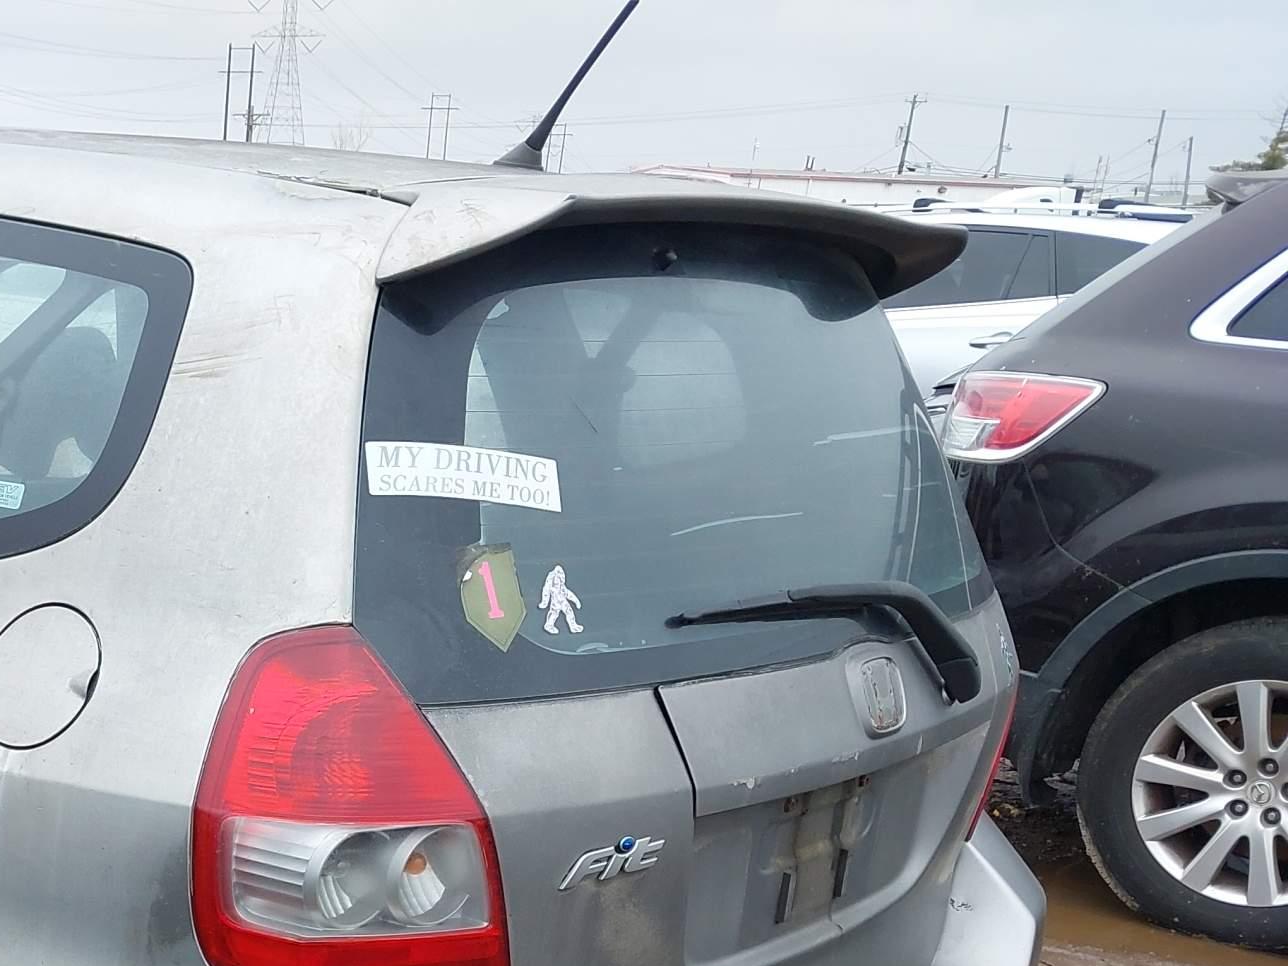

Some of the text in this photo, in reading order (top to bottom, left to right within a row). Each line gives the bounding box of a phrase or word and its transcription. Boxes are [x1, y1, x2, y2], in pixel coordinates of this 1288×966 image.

[376, 445, 548, 483] MY DRIVING
[378, 474, 551, 506] SCARES ME TOO!
[478, 560, 505, 619] 1
[559, 835, 665, 891] Fit
